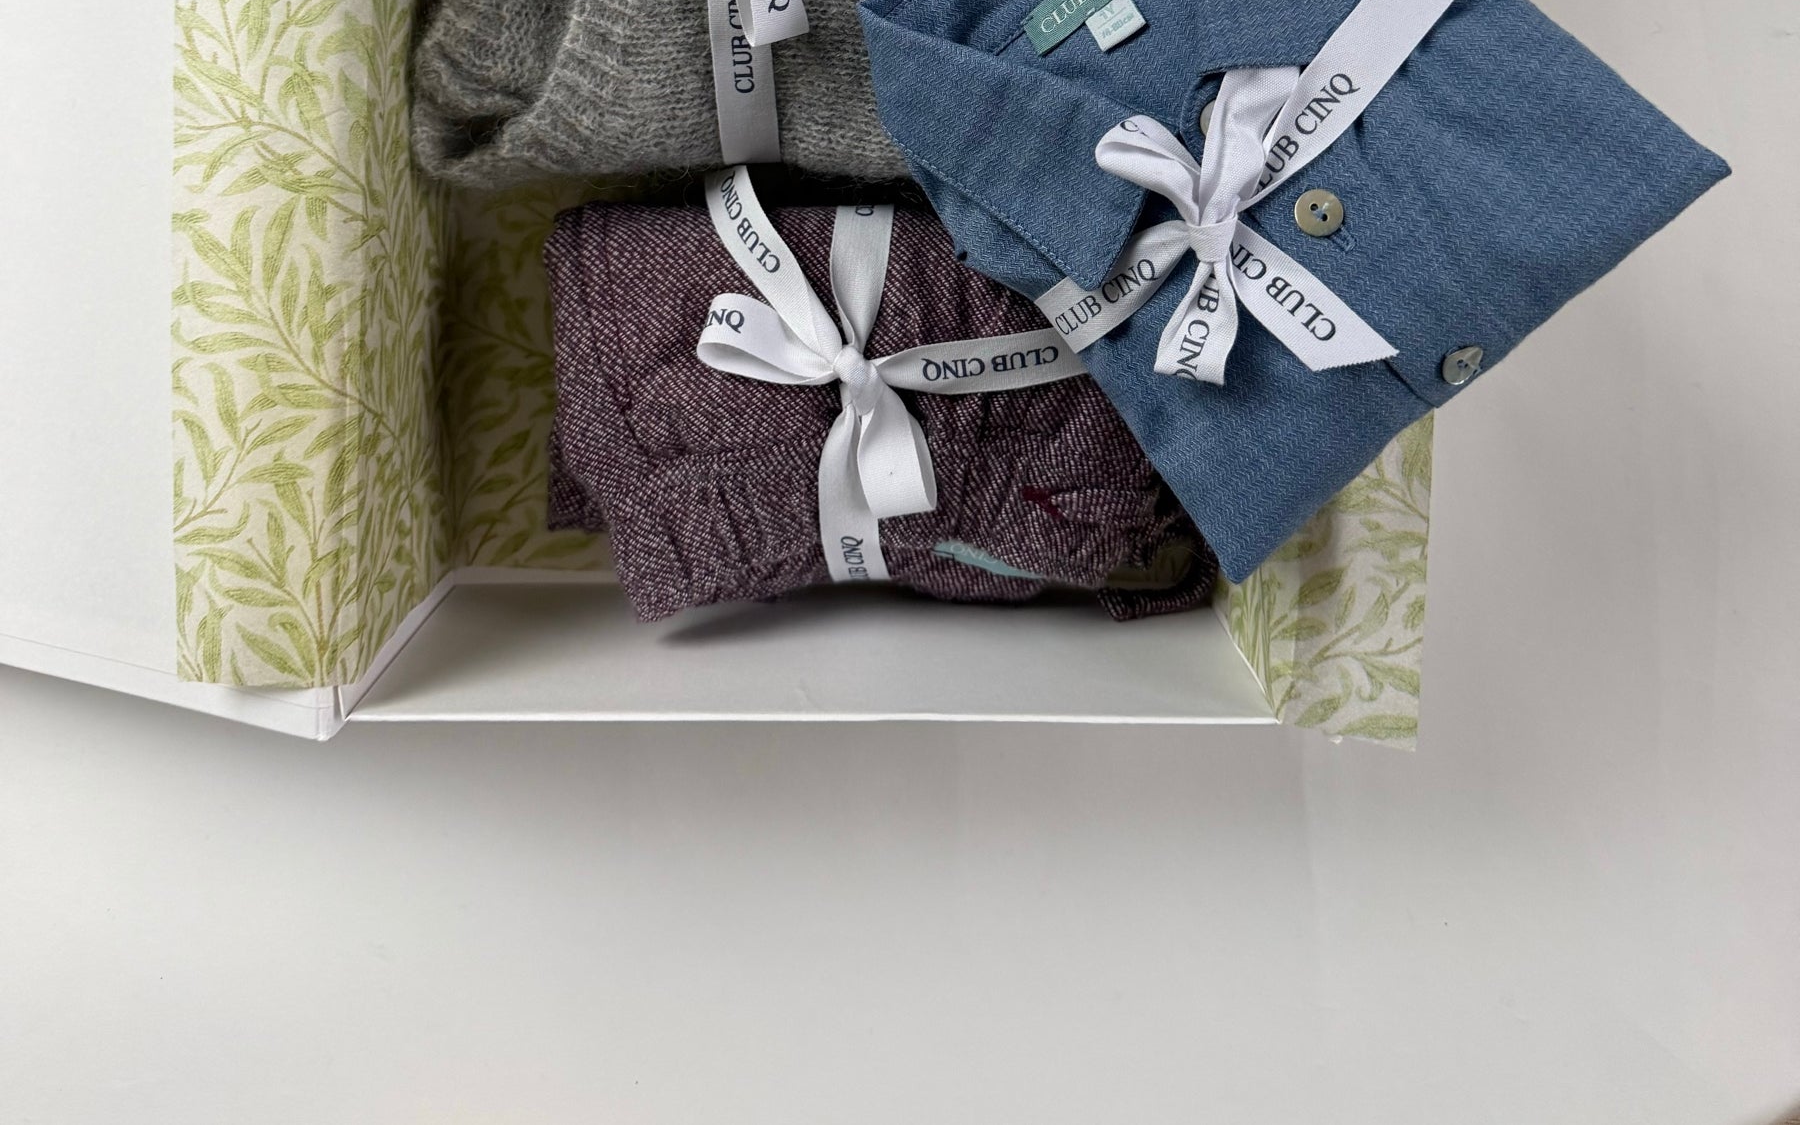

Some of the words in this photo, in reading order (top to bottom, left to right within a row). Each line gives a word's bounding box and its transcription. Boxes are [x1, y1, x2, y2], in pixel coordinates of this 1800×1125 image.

[1256, 135, 1300, 195] LUB
[1294, 73, 1361, 135] CINQ
[720, 170, 743, 220] CINQ
[737, 217, 781, 273] CLUB
[1229, 241, 1267, 280] CIN
[1055, 295, 1102, 335] CLUB
[1102, 258, 1160, 304] CINQ
[1266, 276, 1337, 341] CLUB
[705, 308, 745, 334] NQ
[921, 358, 986, 382] CINQ
[991, 345, 1059, 372] CLUB
[840, 536, 864, 565] CINQ
